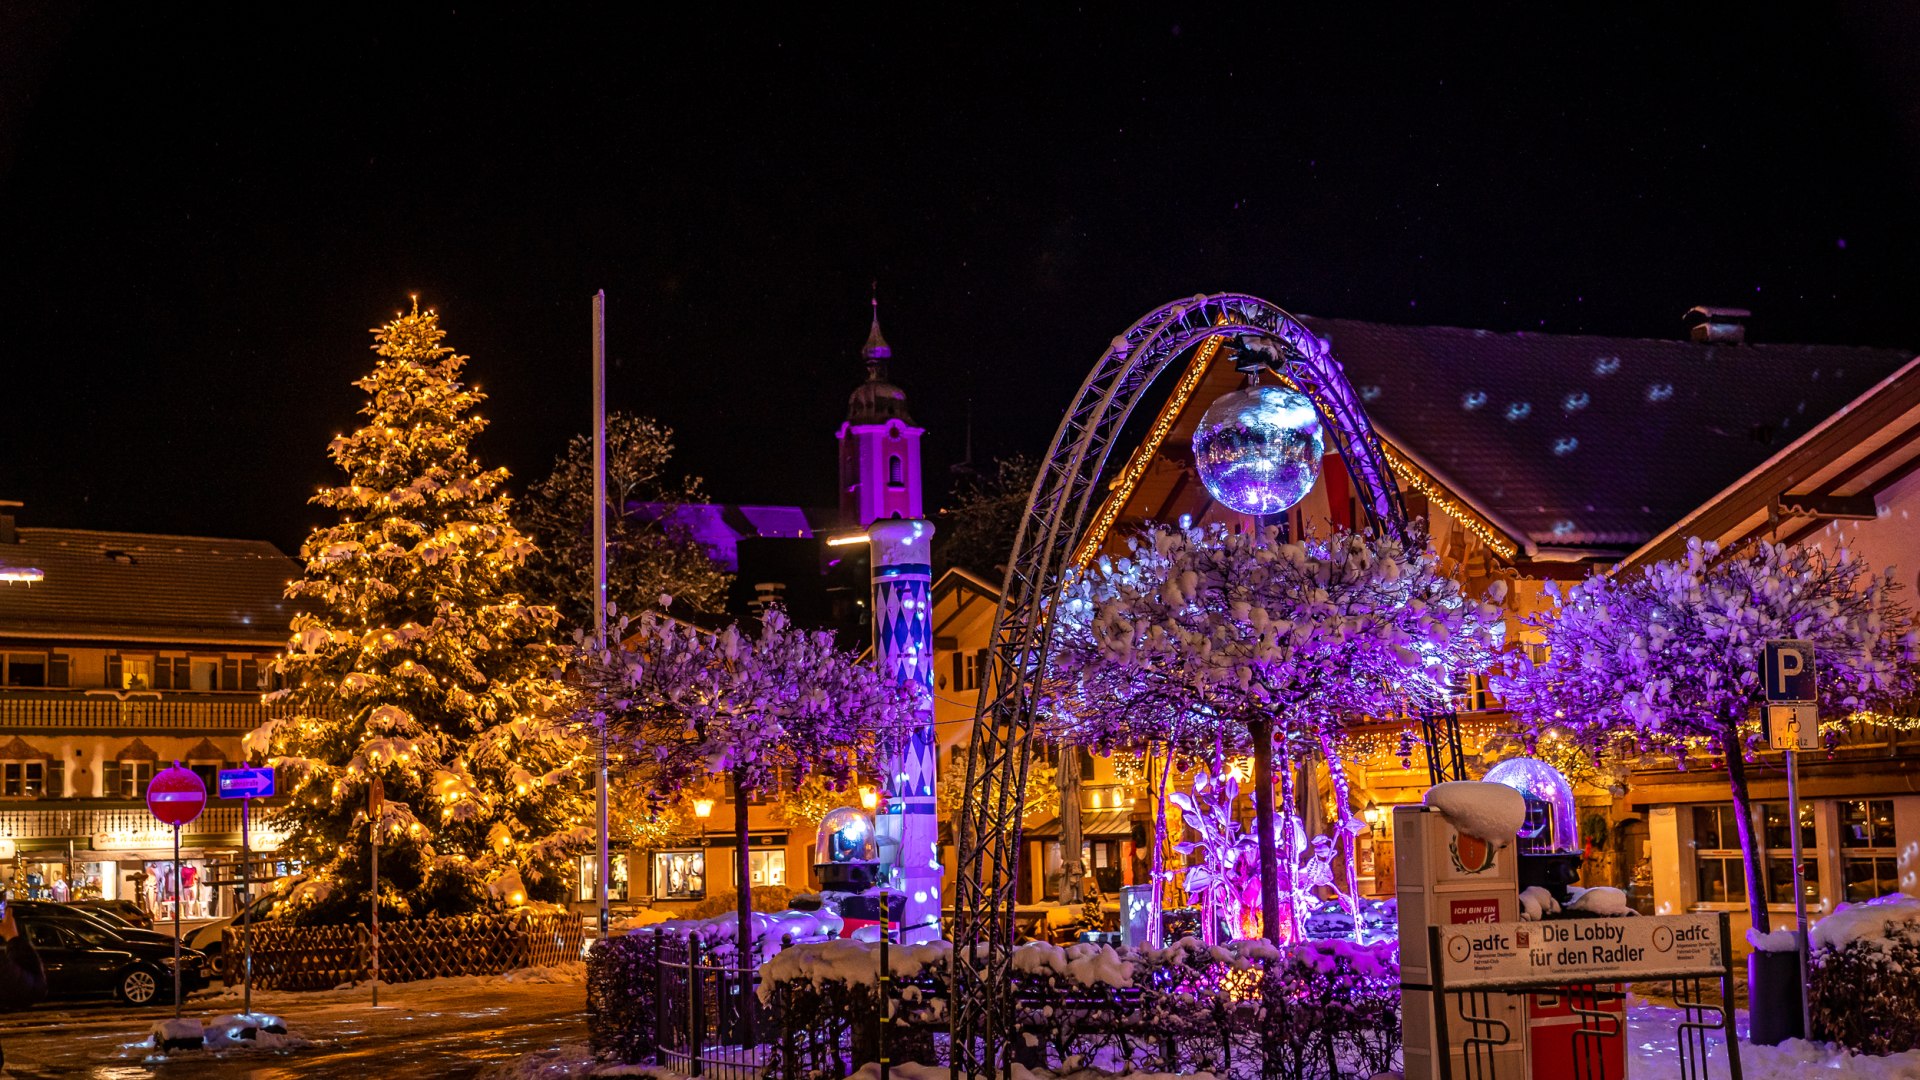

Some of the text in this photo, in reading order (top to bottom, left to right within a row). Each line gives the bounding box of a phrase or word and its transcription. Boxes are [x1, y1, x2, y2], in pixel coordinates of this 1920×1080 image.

[1778, 649, 1804, 694] P
[1777, 736, 1782, 746] 1
[1454, 907, 1468, 915] ICH
[1543, 922, 1625, 944] Die Lobby
[1676, 924, 1711, 941] adfc
[1473, 934, 1510, 952] adfc
[1529, 944, 1645, 967] für den Radler
